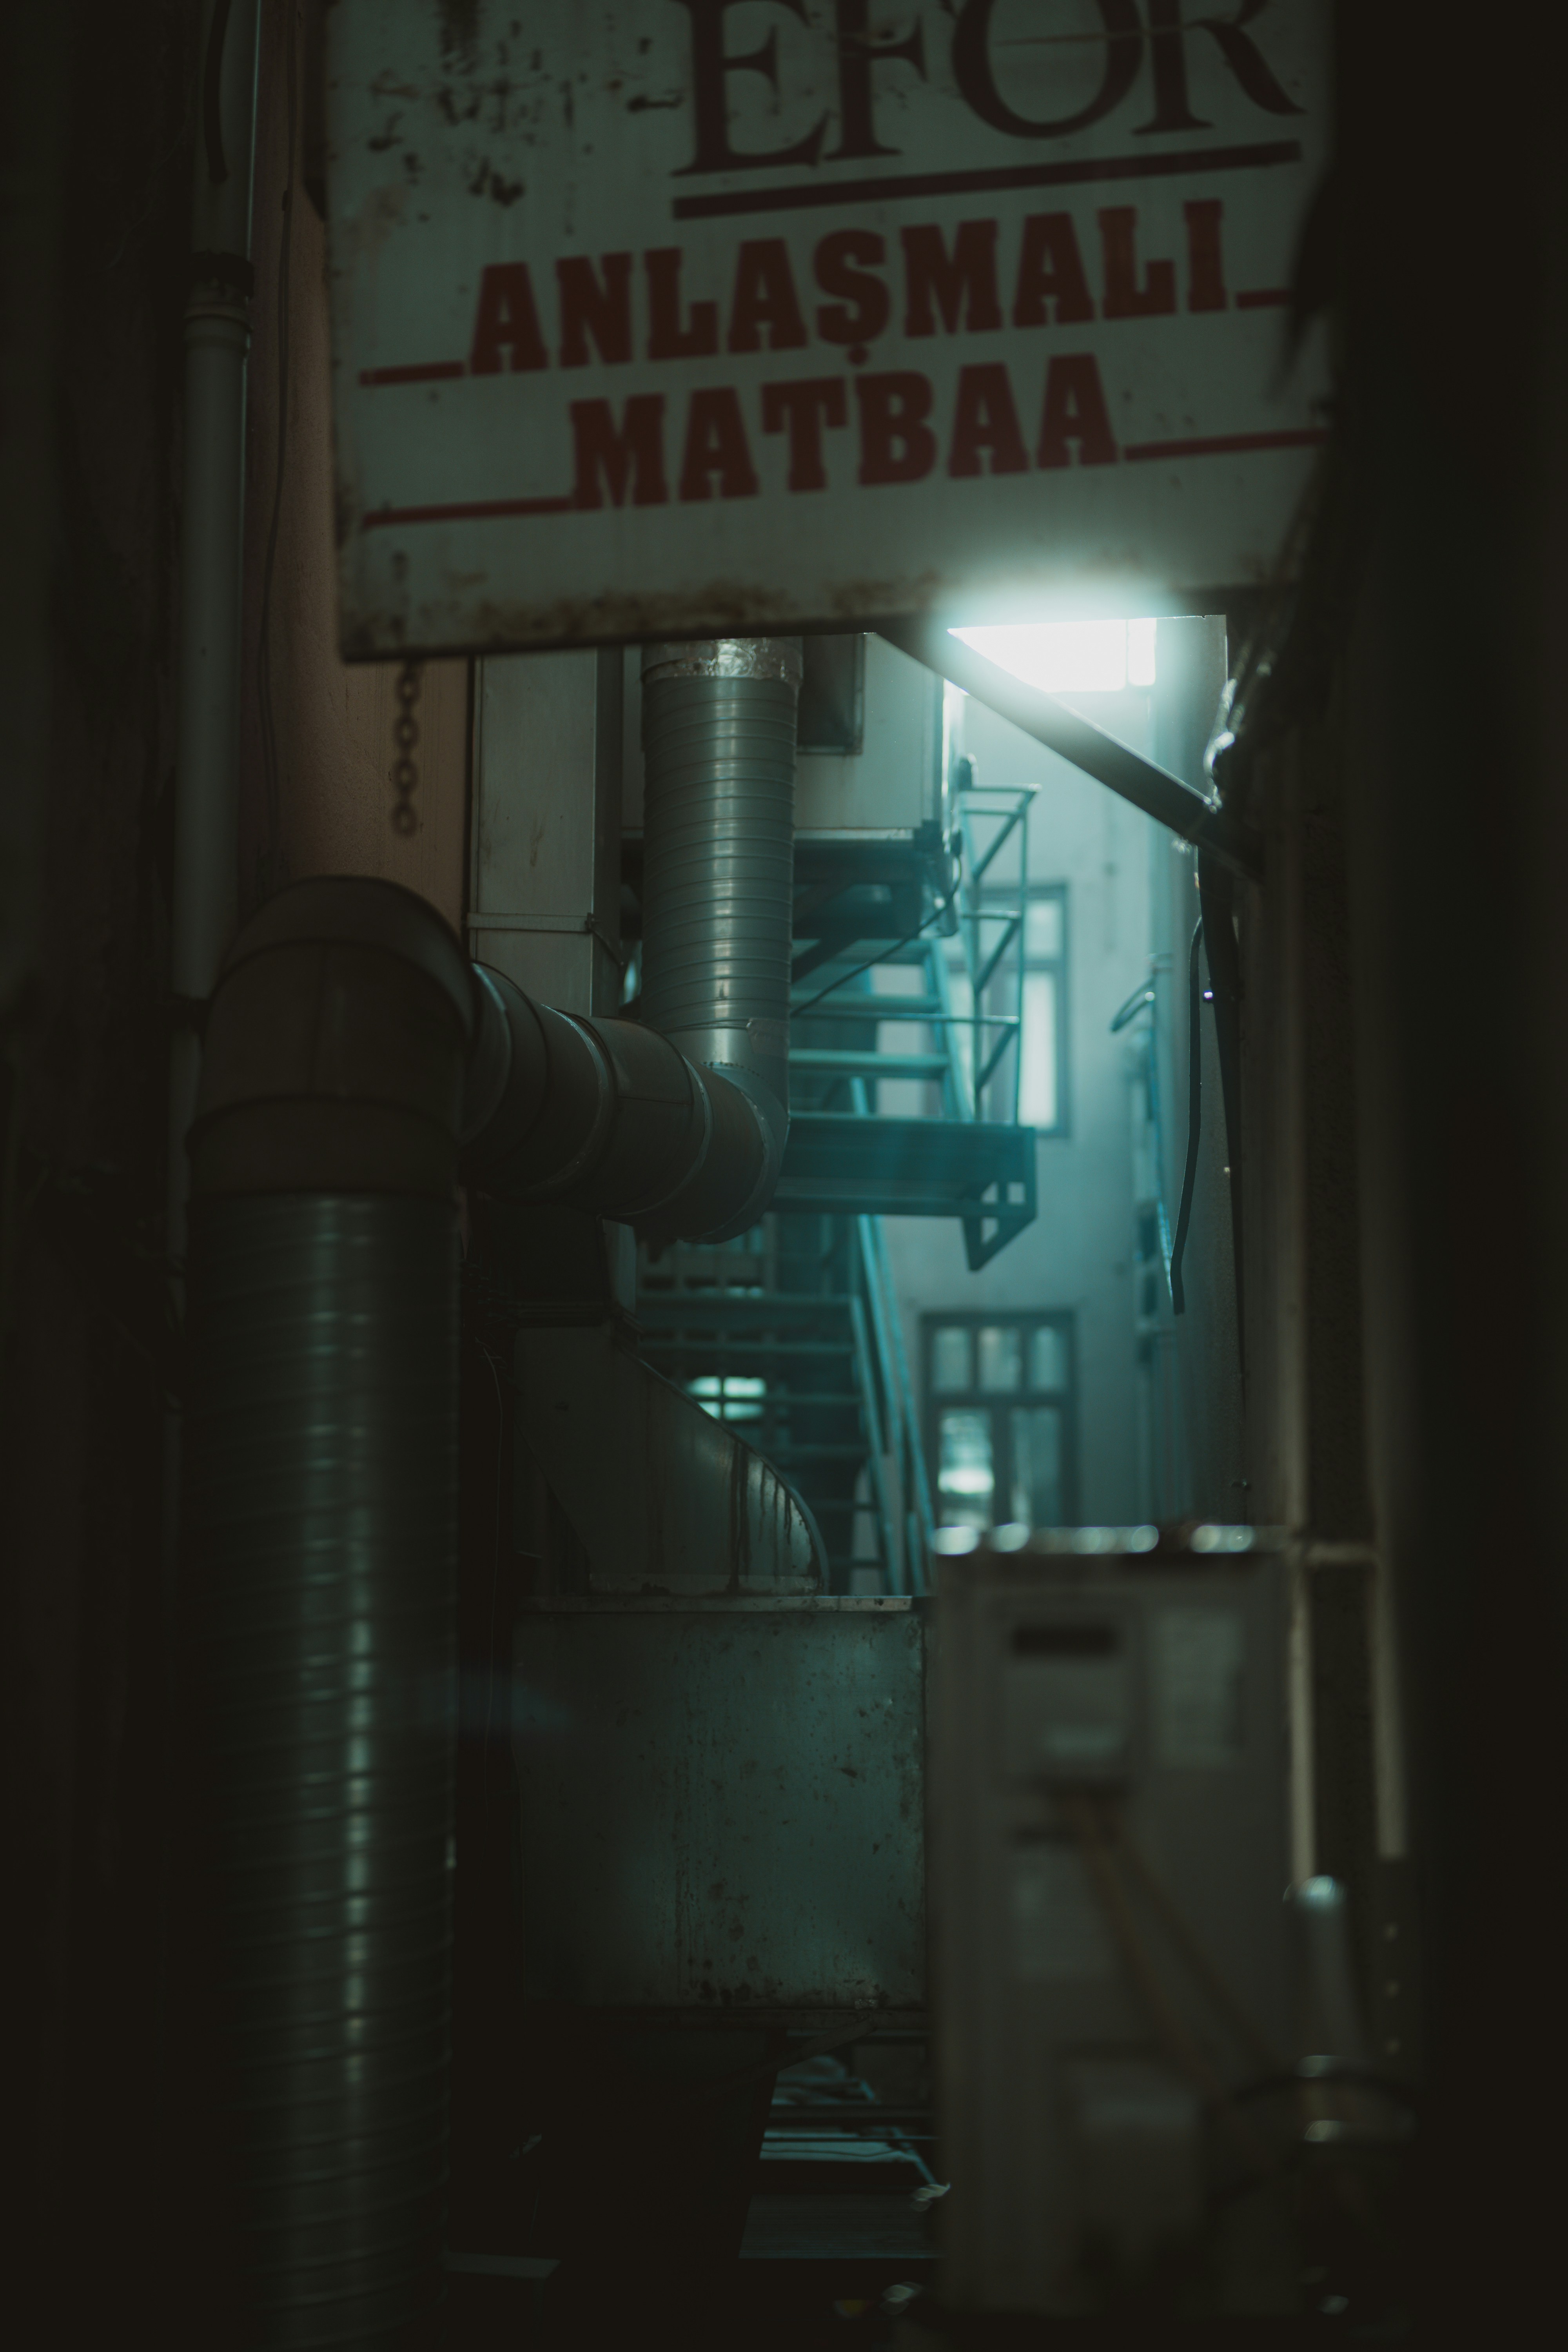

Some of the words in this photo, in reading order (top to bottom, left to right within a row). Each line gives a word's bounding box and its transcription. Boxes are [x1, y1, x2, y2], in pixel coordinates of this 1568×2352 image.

[670, 0, 1307, 176] EFOR
[470, 200, 1228, 376] ANLAŞMALI
[570, 353, 1120, 510] MATBAA
